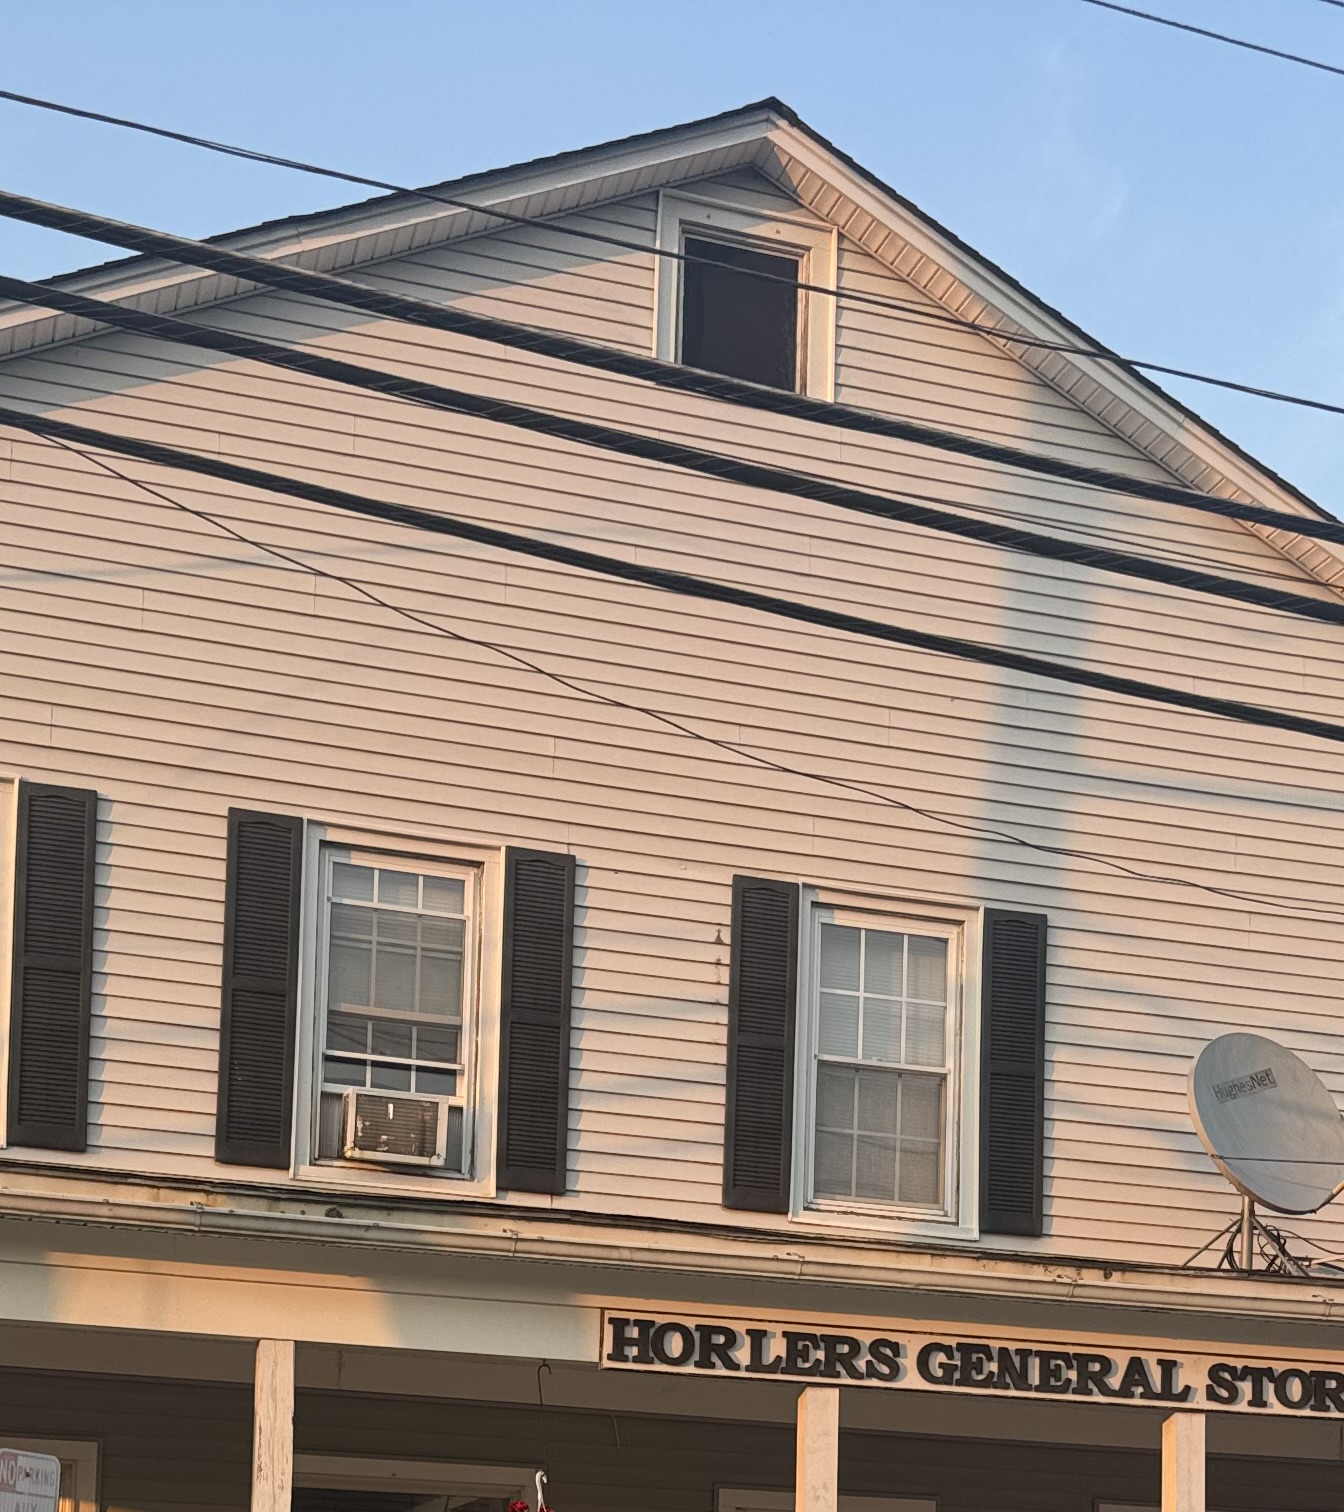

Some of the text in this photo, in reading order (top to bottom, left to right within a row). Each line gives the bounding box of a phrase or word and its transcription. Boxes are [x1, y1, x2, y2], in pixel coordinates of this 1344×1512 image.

[1212, 1072, 1275, 1101] HughesNet
[607, 1316, 902, 1382] HORLERS
[916, 1341, 1193, 1403] GENERAL
[0, 1459, 55, 1487] NO PARKING
